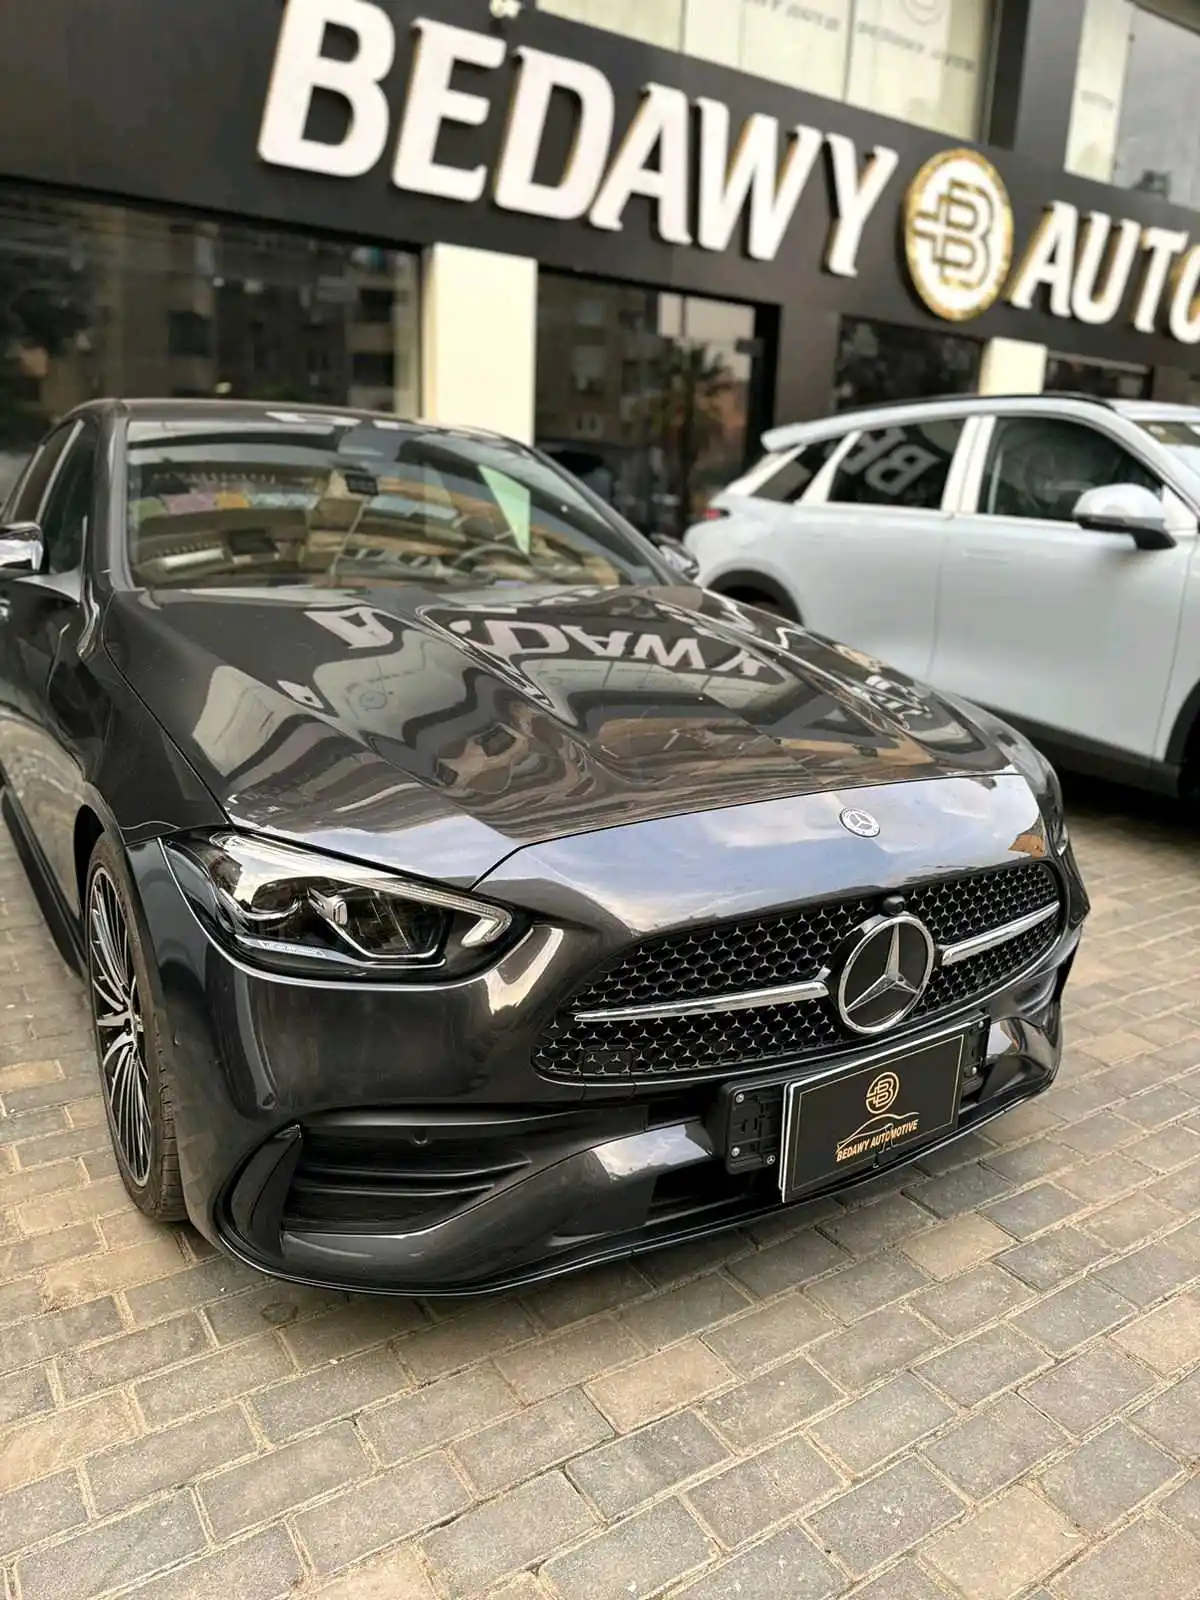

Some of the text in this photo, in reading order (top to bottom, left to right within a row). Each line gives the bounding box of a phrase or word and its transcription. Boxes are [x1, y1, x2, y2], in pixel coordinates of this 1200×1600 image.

[257, 0, 898, 278] BEDAWY
[836, 1119, 919, 1162] BEDAWY AUTOMOTIVE
